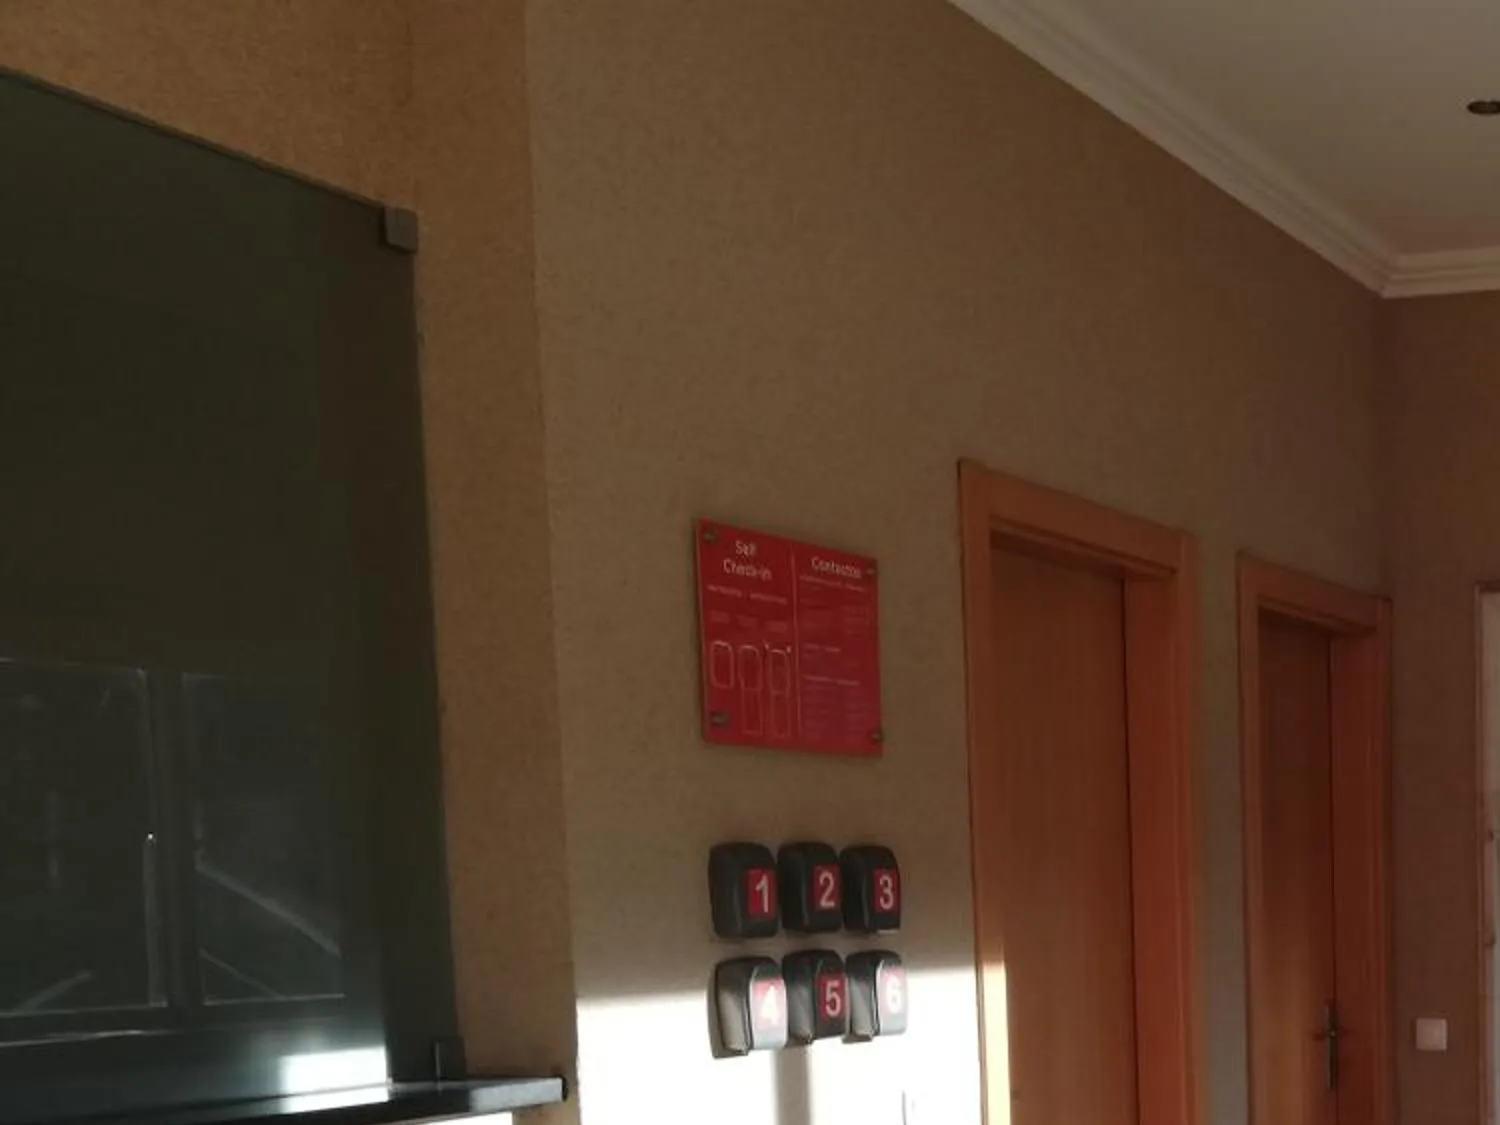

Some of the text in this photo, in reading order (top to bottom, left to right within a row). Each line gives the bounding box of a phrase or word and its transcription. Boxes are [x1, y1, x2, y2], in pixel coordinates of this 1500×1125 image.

[755, 875, 769, 913] 1
[819, 870, 836, 908] 2
[879, 875, 895, 910] 3
[759, 985, 778, 1025] 4
[825, 979, 842, 1017] 5
[886, 975, 903, 1014] 6
